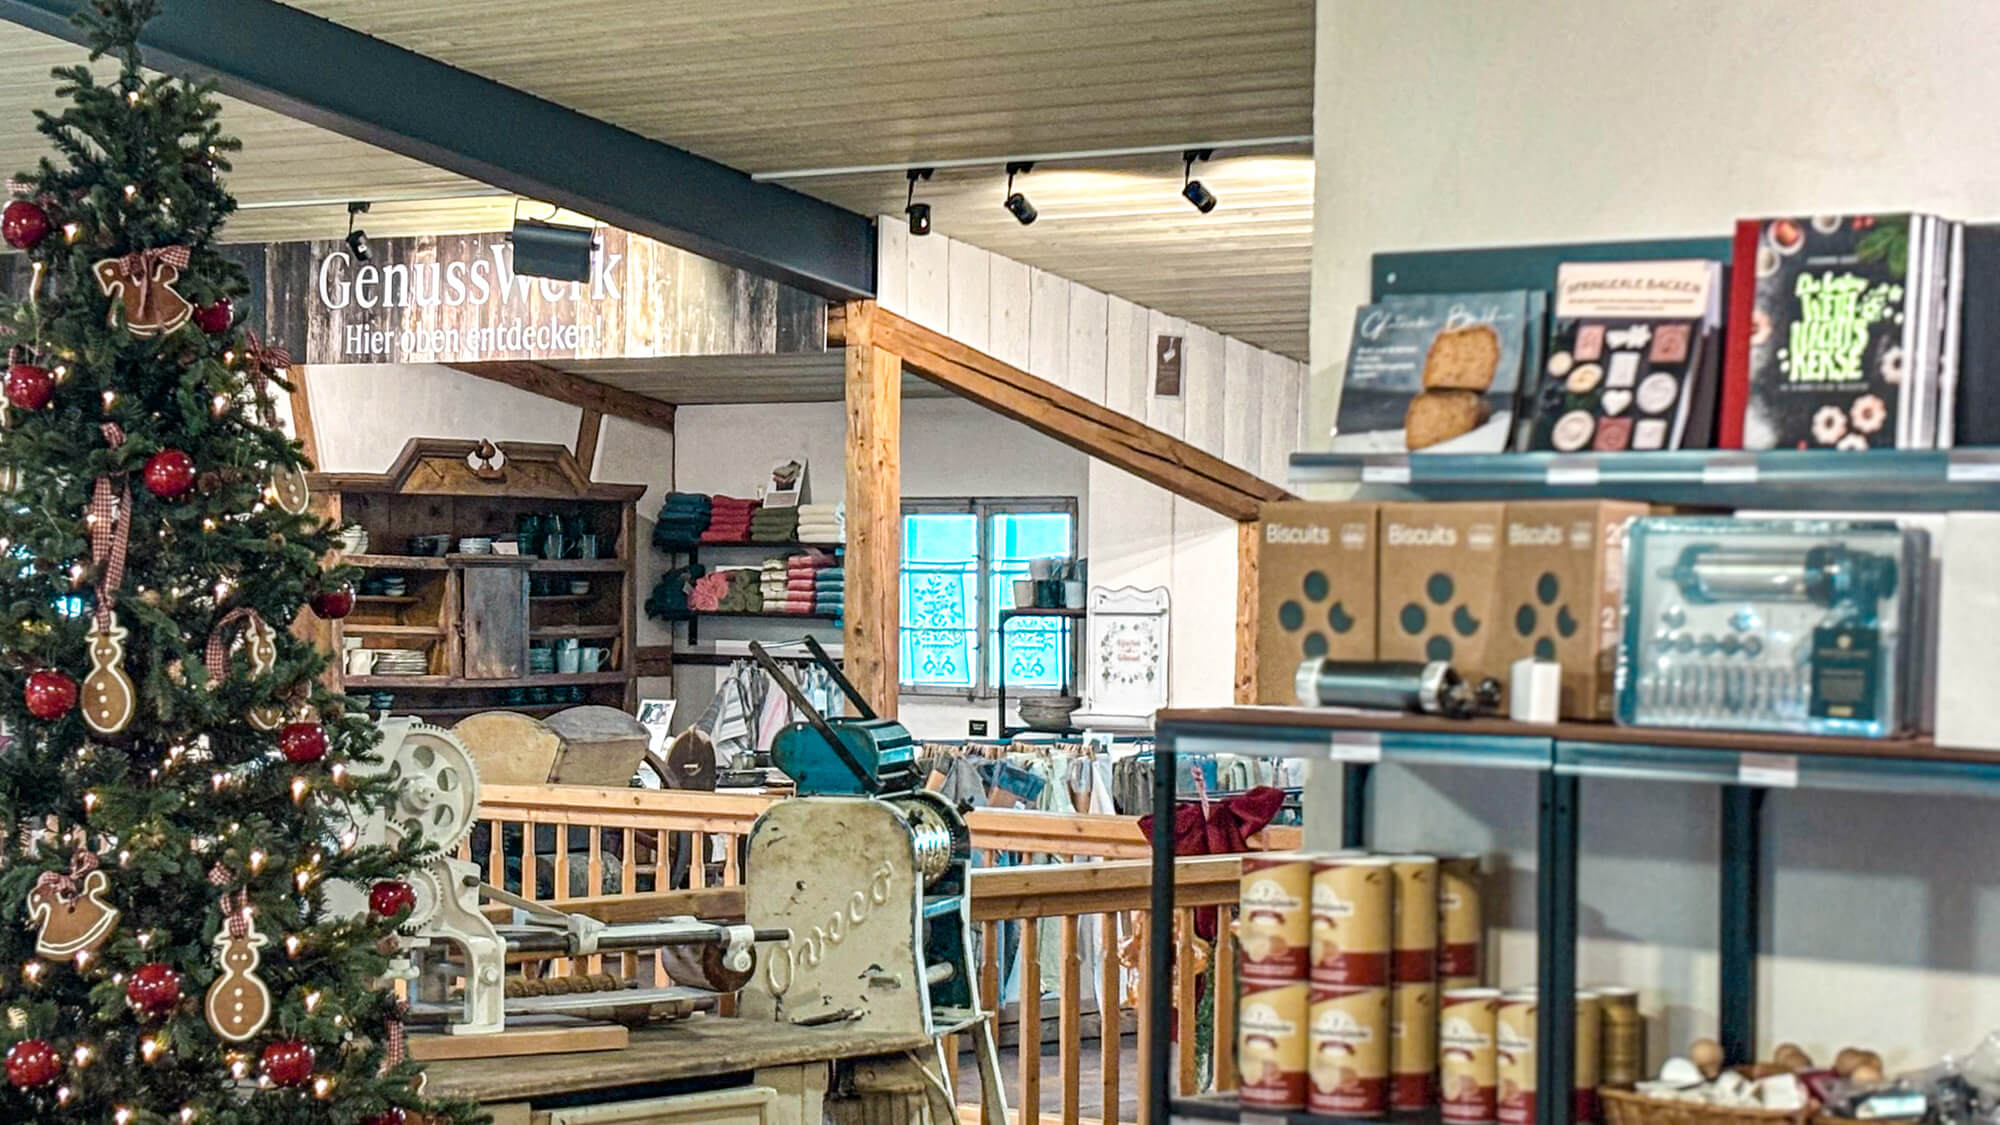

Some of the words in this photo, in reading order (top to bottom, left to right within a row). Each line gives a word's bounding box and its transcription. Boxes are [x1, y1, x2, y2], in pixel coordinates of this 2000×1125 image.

[345, 323, 394, 354] Hier
[400, 324, 459, 351] oben
[466, 313, 602, 350] entdecken!
[1789, 348, 1863, 382] KEKSE
[1266, 523, 1330, 544] Biscuits
[1388, 523, 1457, 545] Biscuits
